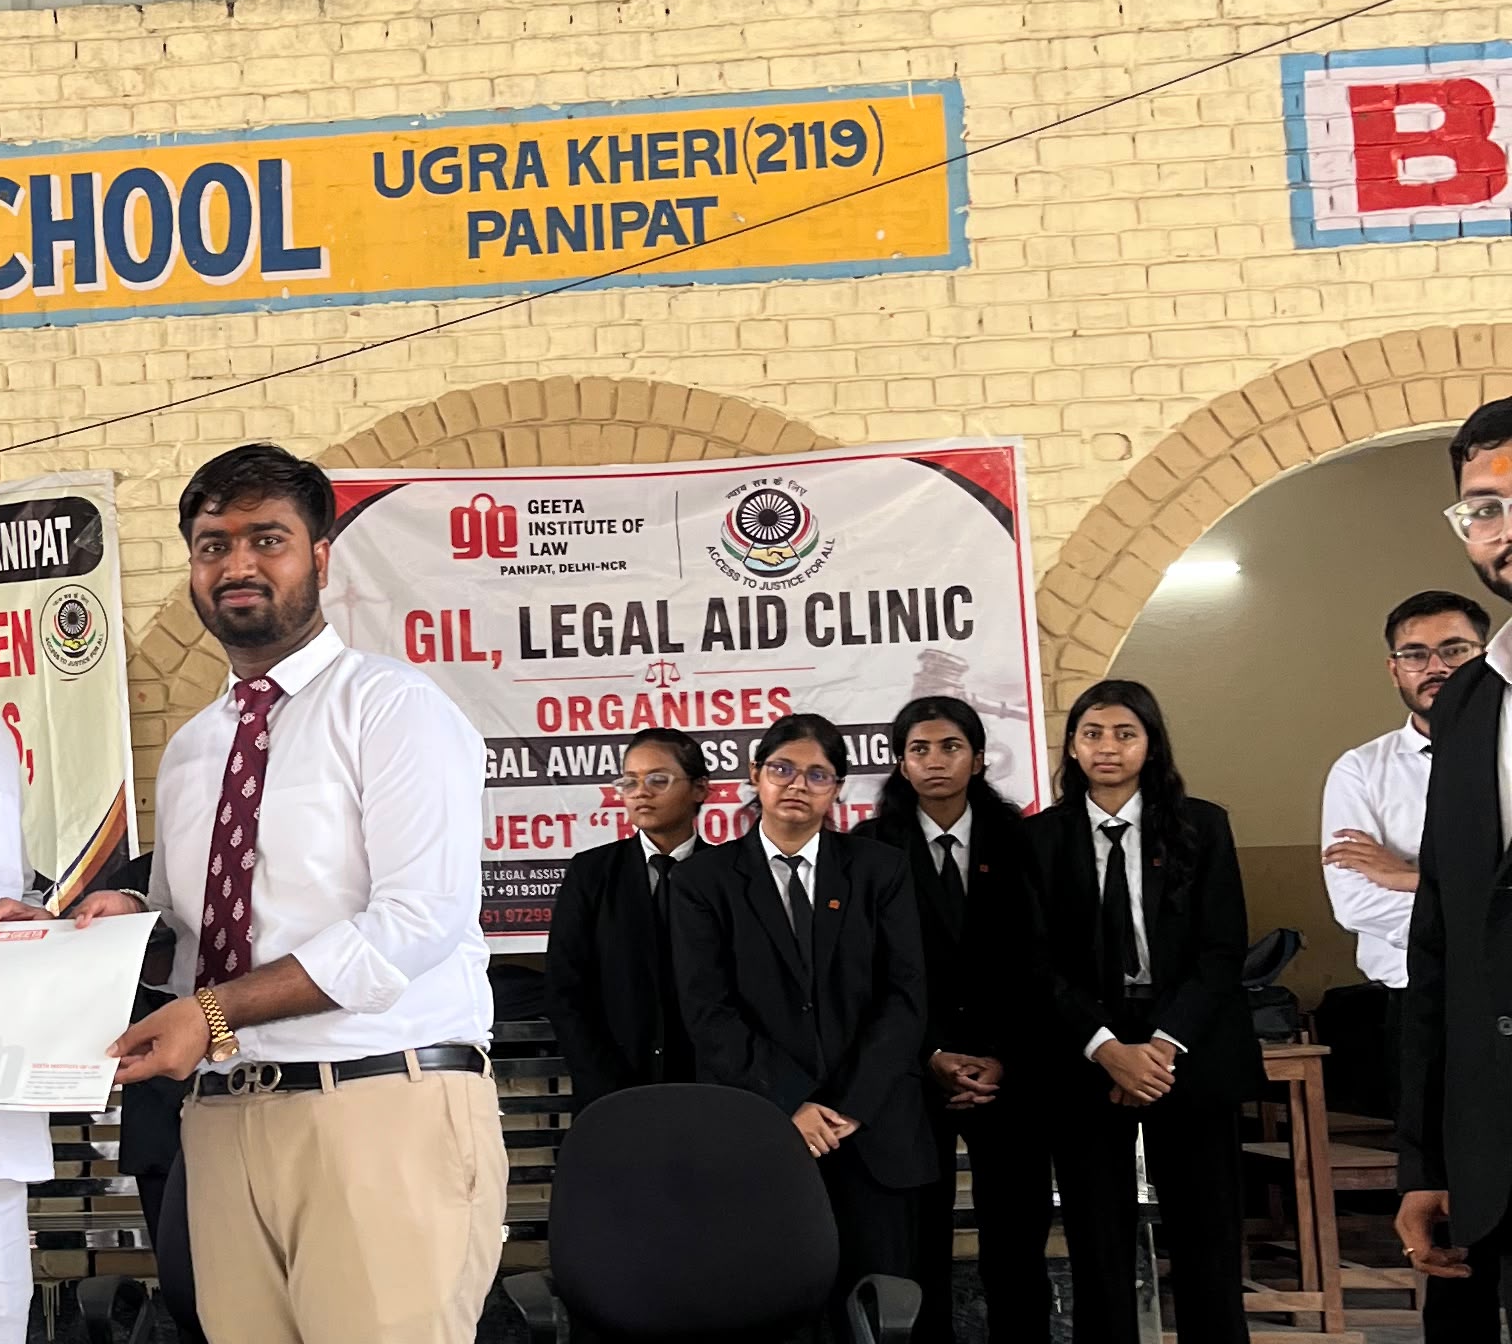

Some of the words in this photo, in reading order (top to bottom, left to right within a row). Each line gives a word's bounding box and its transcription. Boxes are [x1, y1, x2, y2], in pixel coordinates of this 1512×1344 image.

[1348, 77, 1508, 213] B
[374, 139, 549, 199] UGRA
[467, 196, 719, 260] PANIPAT
[528, 499, 585, 515] GEETA
[528, 520, 617, 537] INSTITUTE
[622, 518, 645, 535] OF
[529, 541, 568, 557] LAW
[706, 546, 741, 581] ACCESS
[743, 576, 757, 588] TO
[759, 573, 806, 591] JUSTICE
[804, 558, 826, 578] FOR
[821, 538, 836, 560] ALL
[500, 562, 556, 576] PANIPAT,
[558, 560, 627, 574] DELHI-NCR
[404, 608, 503, 670] GIL,
[520, 599, 685, 659] LEGAL
[701, 595, 788, 652] AID
[805, 585, 974, 648] CLINIC
[537, 686, 793, 733] ORGANISES
[485, 747, 538, 779] GAL
[484, 813, 577, 851] JECT
[494, 870, 526, 881] LEGAL
[521, 883, 563, 896] 93107
